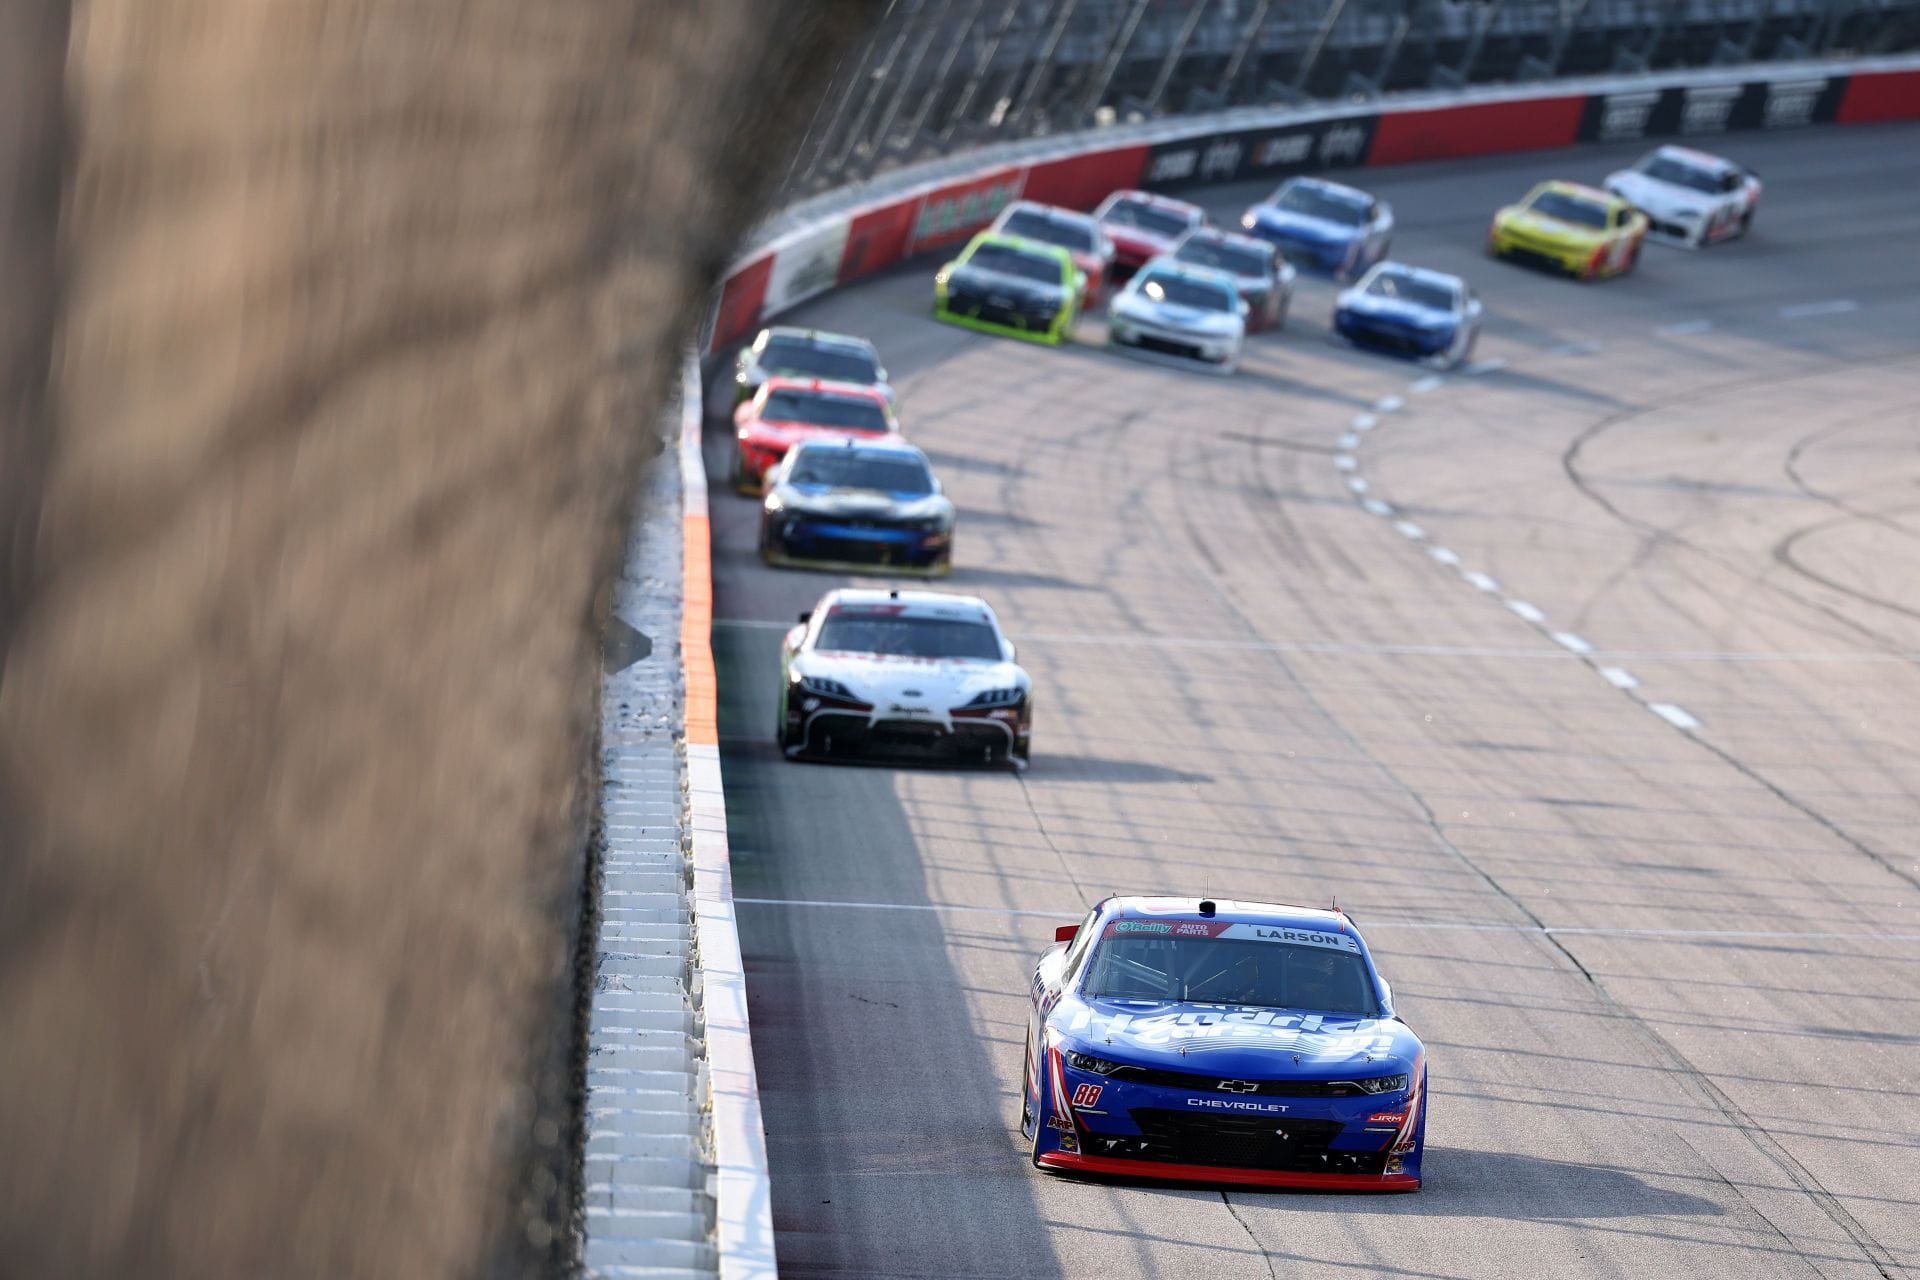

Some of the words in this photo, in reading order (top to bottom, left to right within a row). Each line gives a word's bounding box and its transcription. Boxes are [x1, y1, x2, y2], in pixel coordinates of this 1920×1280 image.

[1115, 921, 1175, 934] O'Reilly
[1176, 928, 1209, 936] PARTS
[1256, 929, 1339, 945] LARSON
[1072, 1083, 1103, 1108] 88
[1187, 1098, 1290, 1113] CHEVROLET
[1046, 1116, 1075, 1131] ARP
[1370, 1115, 1402, 1123] JRM
[1390, 1141, 1416, 1152] ARP
